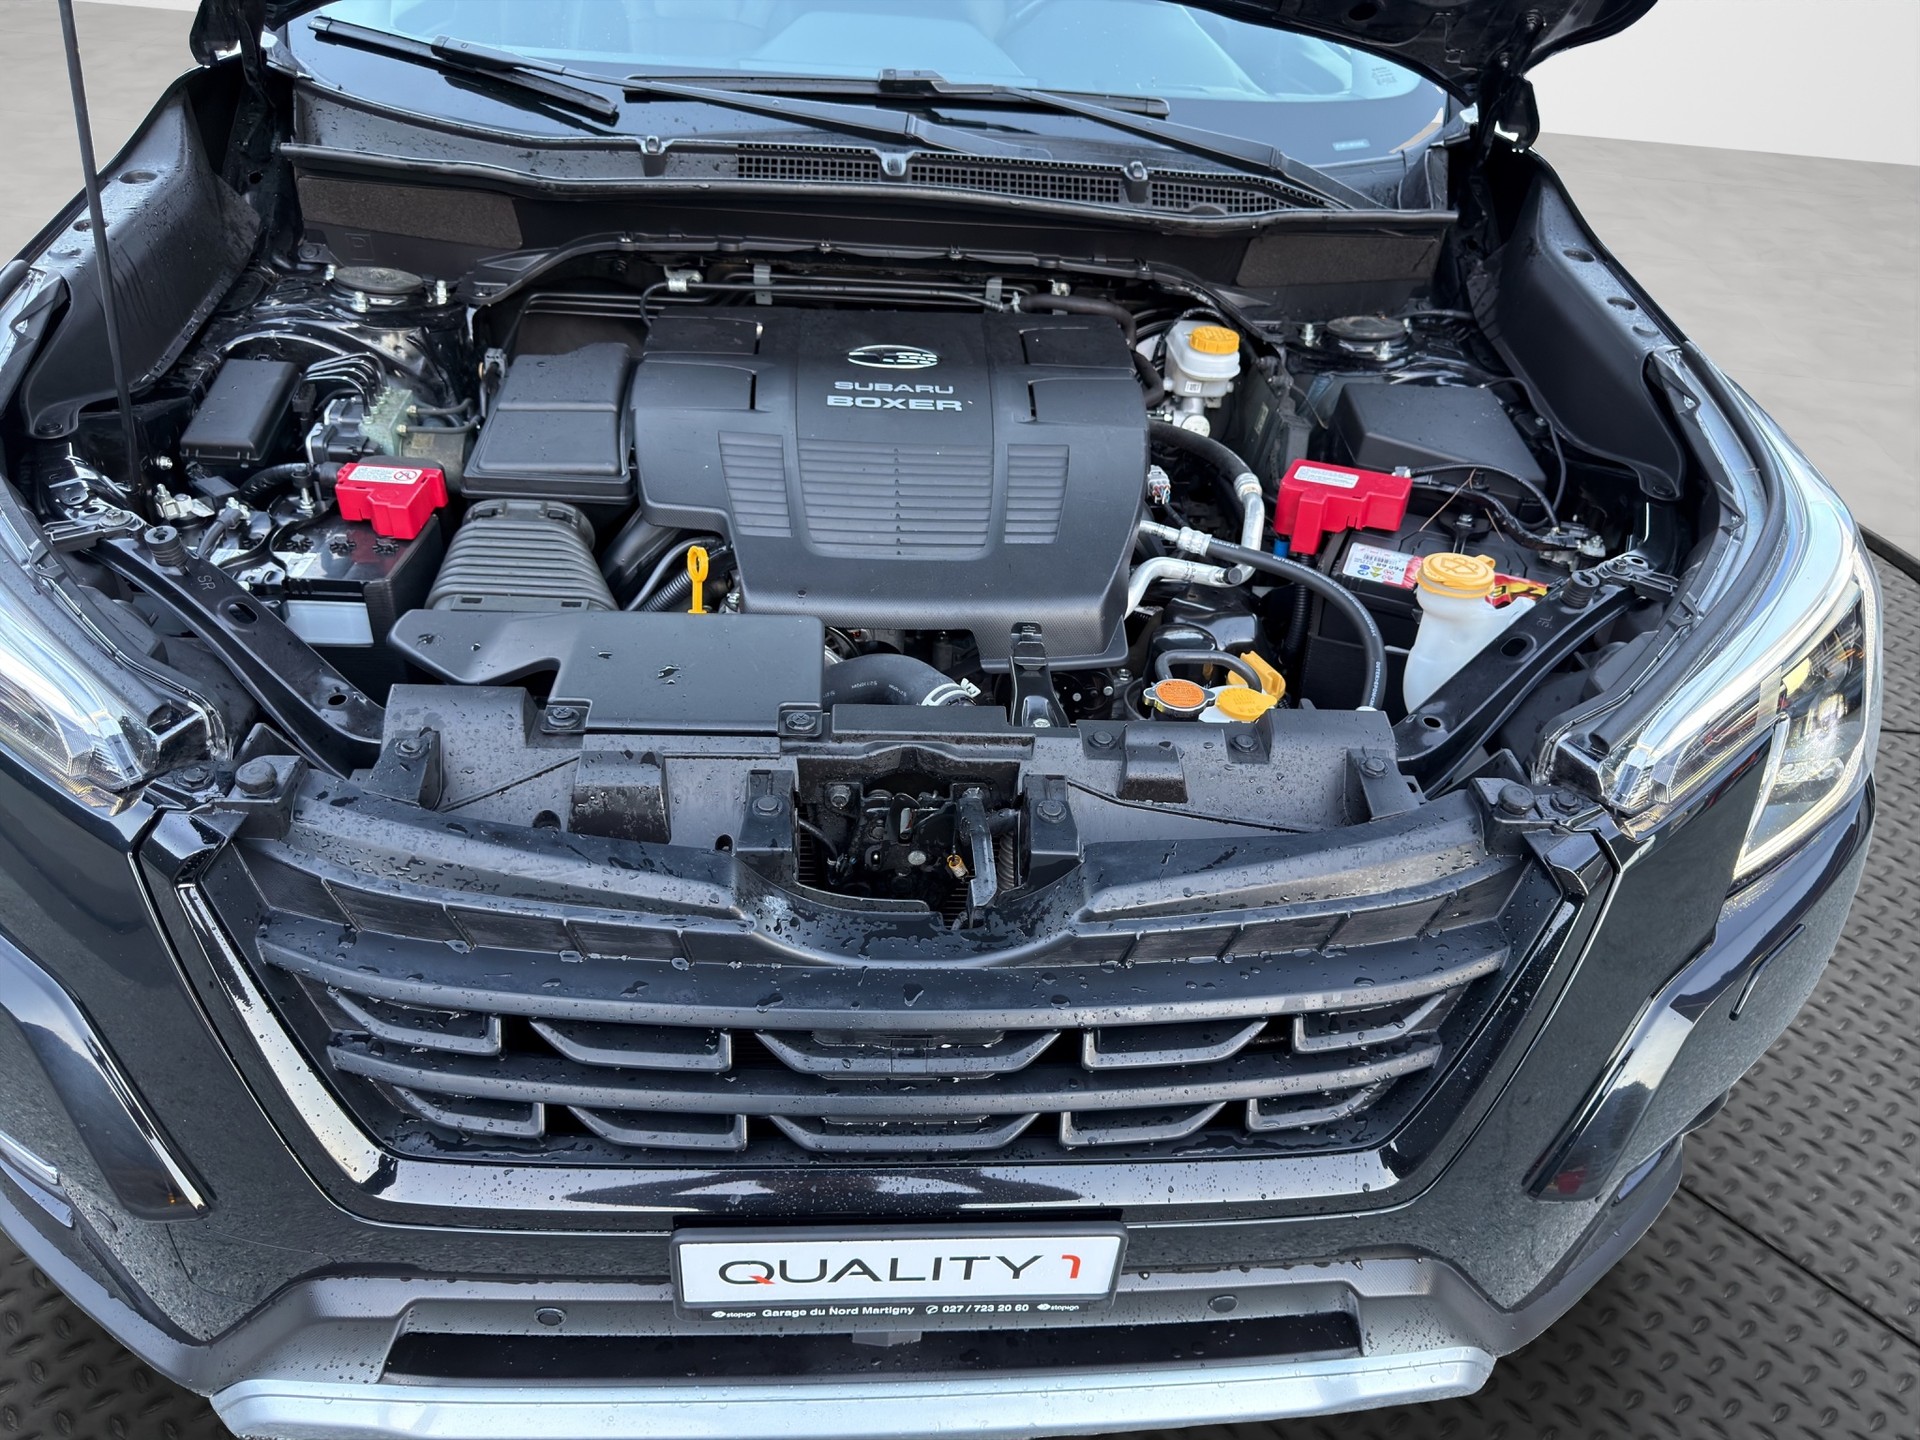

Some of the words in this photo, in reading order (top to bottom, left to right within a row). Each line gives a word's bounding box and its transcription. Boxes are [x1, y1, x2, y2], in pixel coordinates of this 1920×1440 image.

[834, 381, 954, 394] SUBARU
[827, 395, 963, 411] BOXER
[197, 575, 216, 590] SR
[718, 1254, 1045, 1285] QUALITY
[1061, 1254, 1082, 1279] 1
[762, 1308, 807, 1318] Garage
[810, 1307, 826, 1316] du
[829, 1306, 860, 1316] Nord
[862, 1305, 915, 1315] Martigny
[942, 1304, 964, 1313] 027
[974, 1304, 995, 1312] 723
[997, 1303, 1012, 1312] 20
[1014, 1303, 1030, 1312] 60
